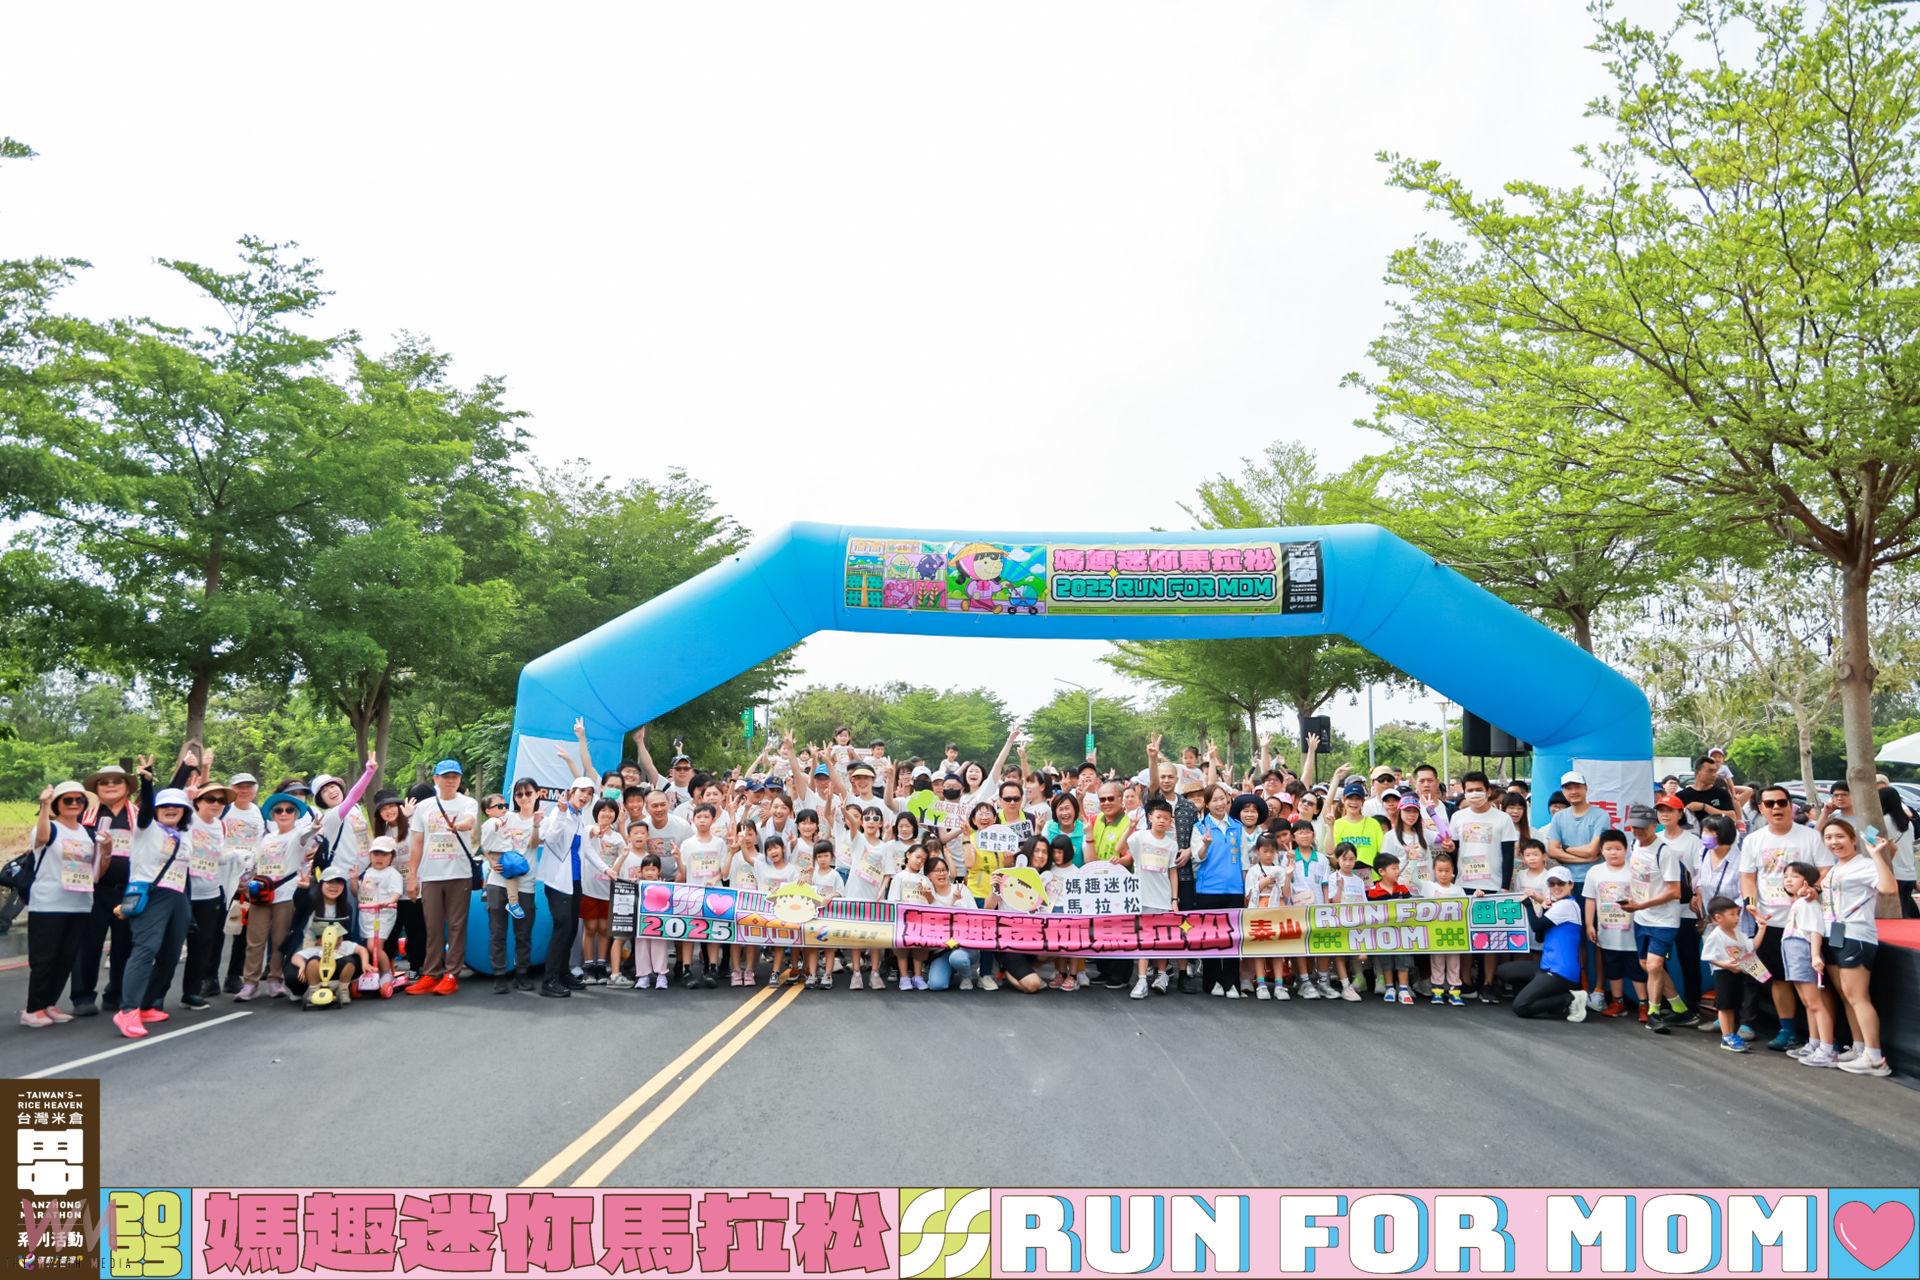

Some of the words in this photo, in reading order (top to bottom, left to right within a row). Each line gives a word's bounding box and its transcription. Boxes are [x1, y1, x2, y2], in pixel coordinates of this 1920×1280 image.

[1055, 577, 1114, 598] 2025
[1115, 577, 1166, 598] RUN
[1167, 577, 1219, 598] FOR
[1219, 577, 1274, 598] MOM
[1065, 876, 1140, 895] 媽趣迷你
[1067, 896, 1141, 914] 馬拉松
[1315, 903, 1391, 928] RUN
[1394, 900, 1464, 923] FOR
[641, 915, 733, 942] 2025
[903, 909, 1235, 952] 媽趣迷你馬拉松
[1249, 918, 1302, 941] 泰山
[1347, 926, 1430, 950] MOM
